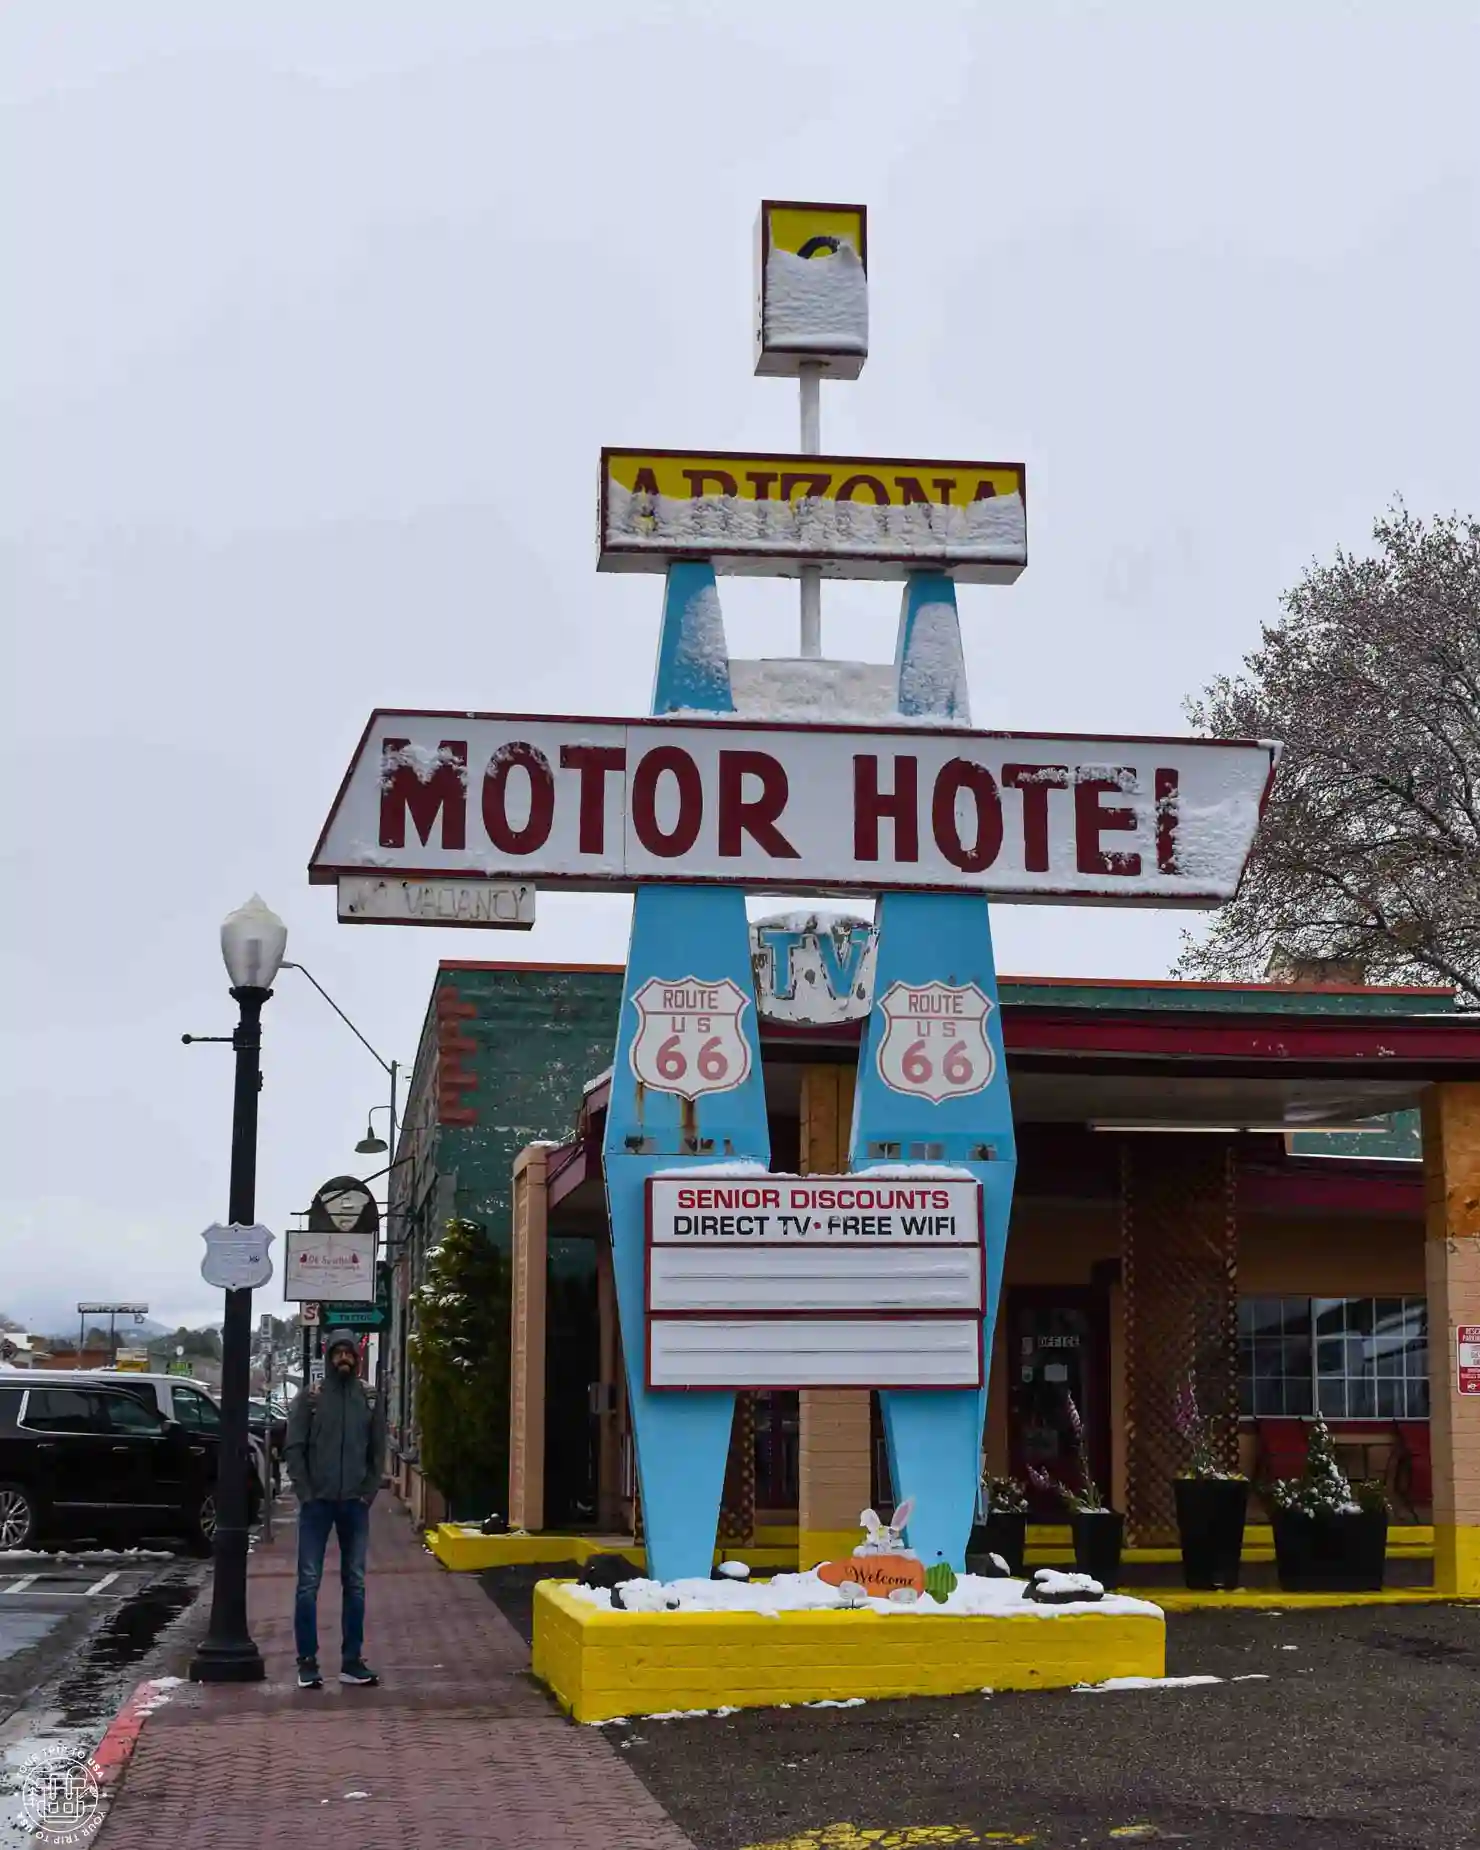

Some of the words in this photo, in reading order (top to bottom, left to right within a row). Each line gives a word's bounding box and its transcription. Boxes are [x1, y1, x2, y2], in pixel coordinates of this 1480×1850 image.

[379, 738, 802, 859] MOTOR
[761, 930, 871, 998] TV
[663, 989, 719, 1009] ROUTE
[908, 994, 964, 1015] ROUTE
[656, 1035, 729, 1080] 66
[902, 1040, 974, 1084] 66
[678, 1189, 780, 1209] SENIOR
[790, 1190, 950, 1210] DISCOUNTS
[673, 1216, 770, 1236] DIRECT
[827, 1216, 892, 1236] FREE
[900, 1216, 956, 1236] WIFI
[844, 1565, 914, 1585] Welcome
